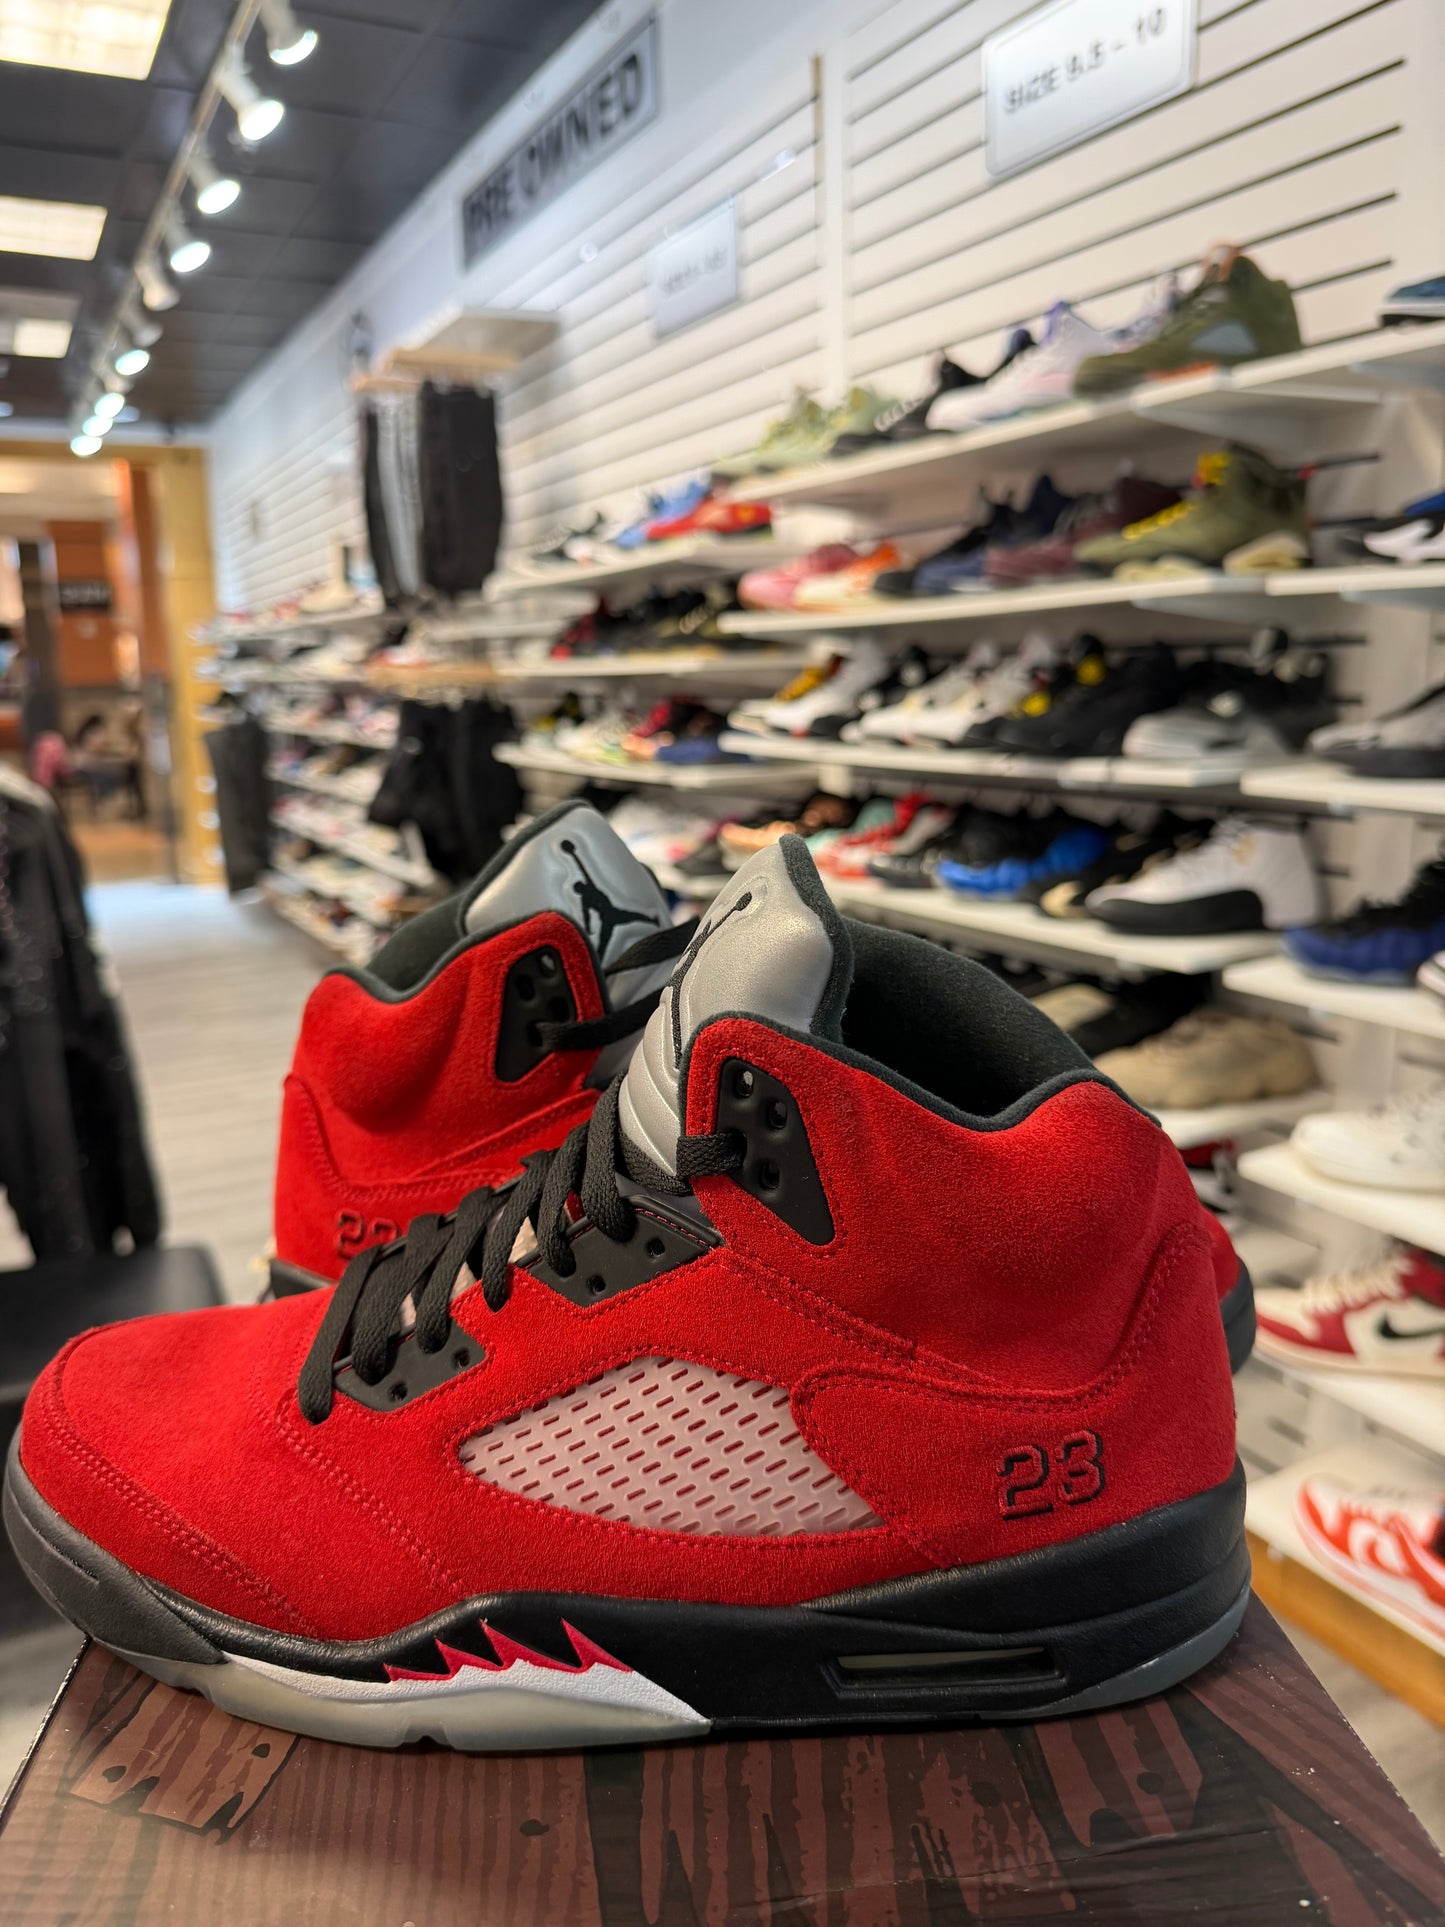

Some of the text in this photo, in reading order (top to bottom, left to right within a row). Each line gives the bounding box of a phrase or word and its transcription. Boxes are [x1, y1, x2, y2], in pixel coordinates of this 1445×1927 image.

[1003, 66, 1060, 115] SIZE
[1134, 7, 1167, 46] 10
[466, 52, 642, 236] PRE OWNED
[996, 1427, 1105, 1520] 23
